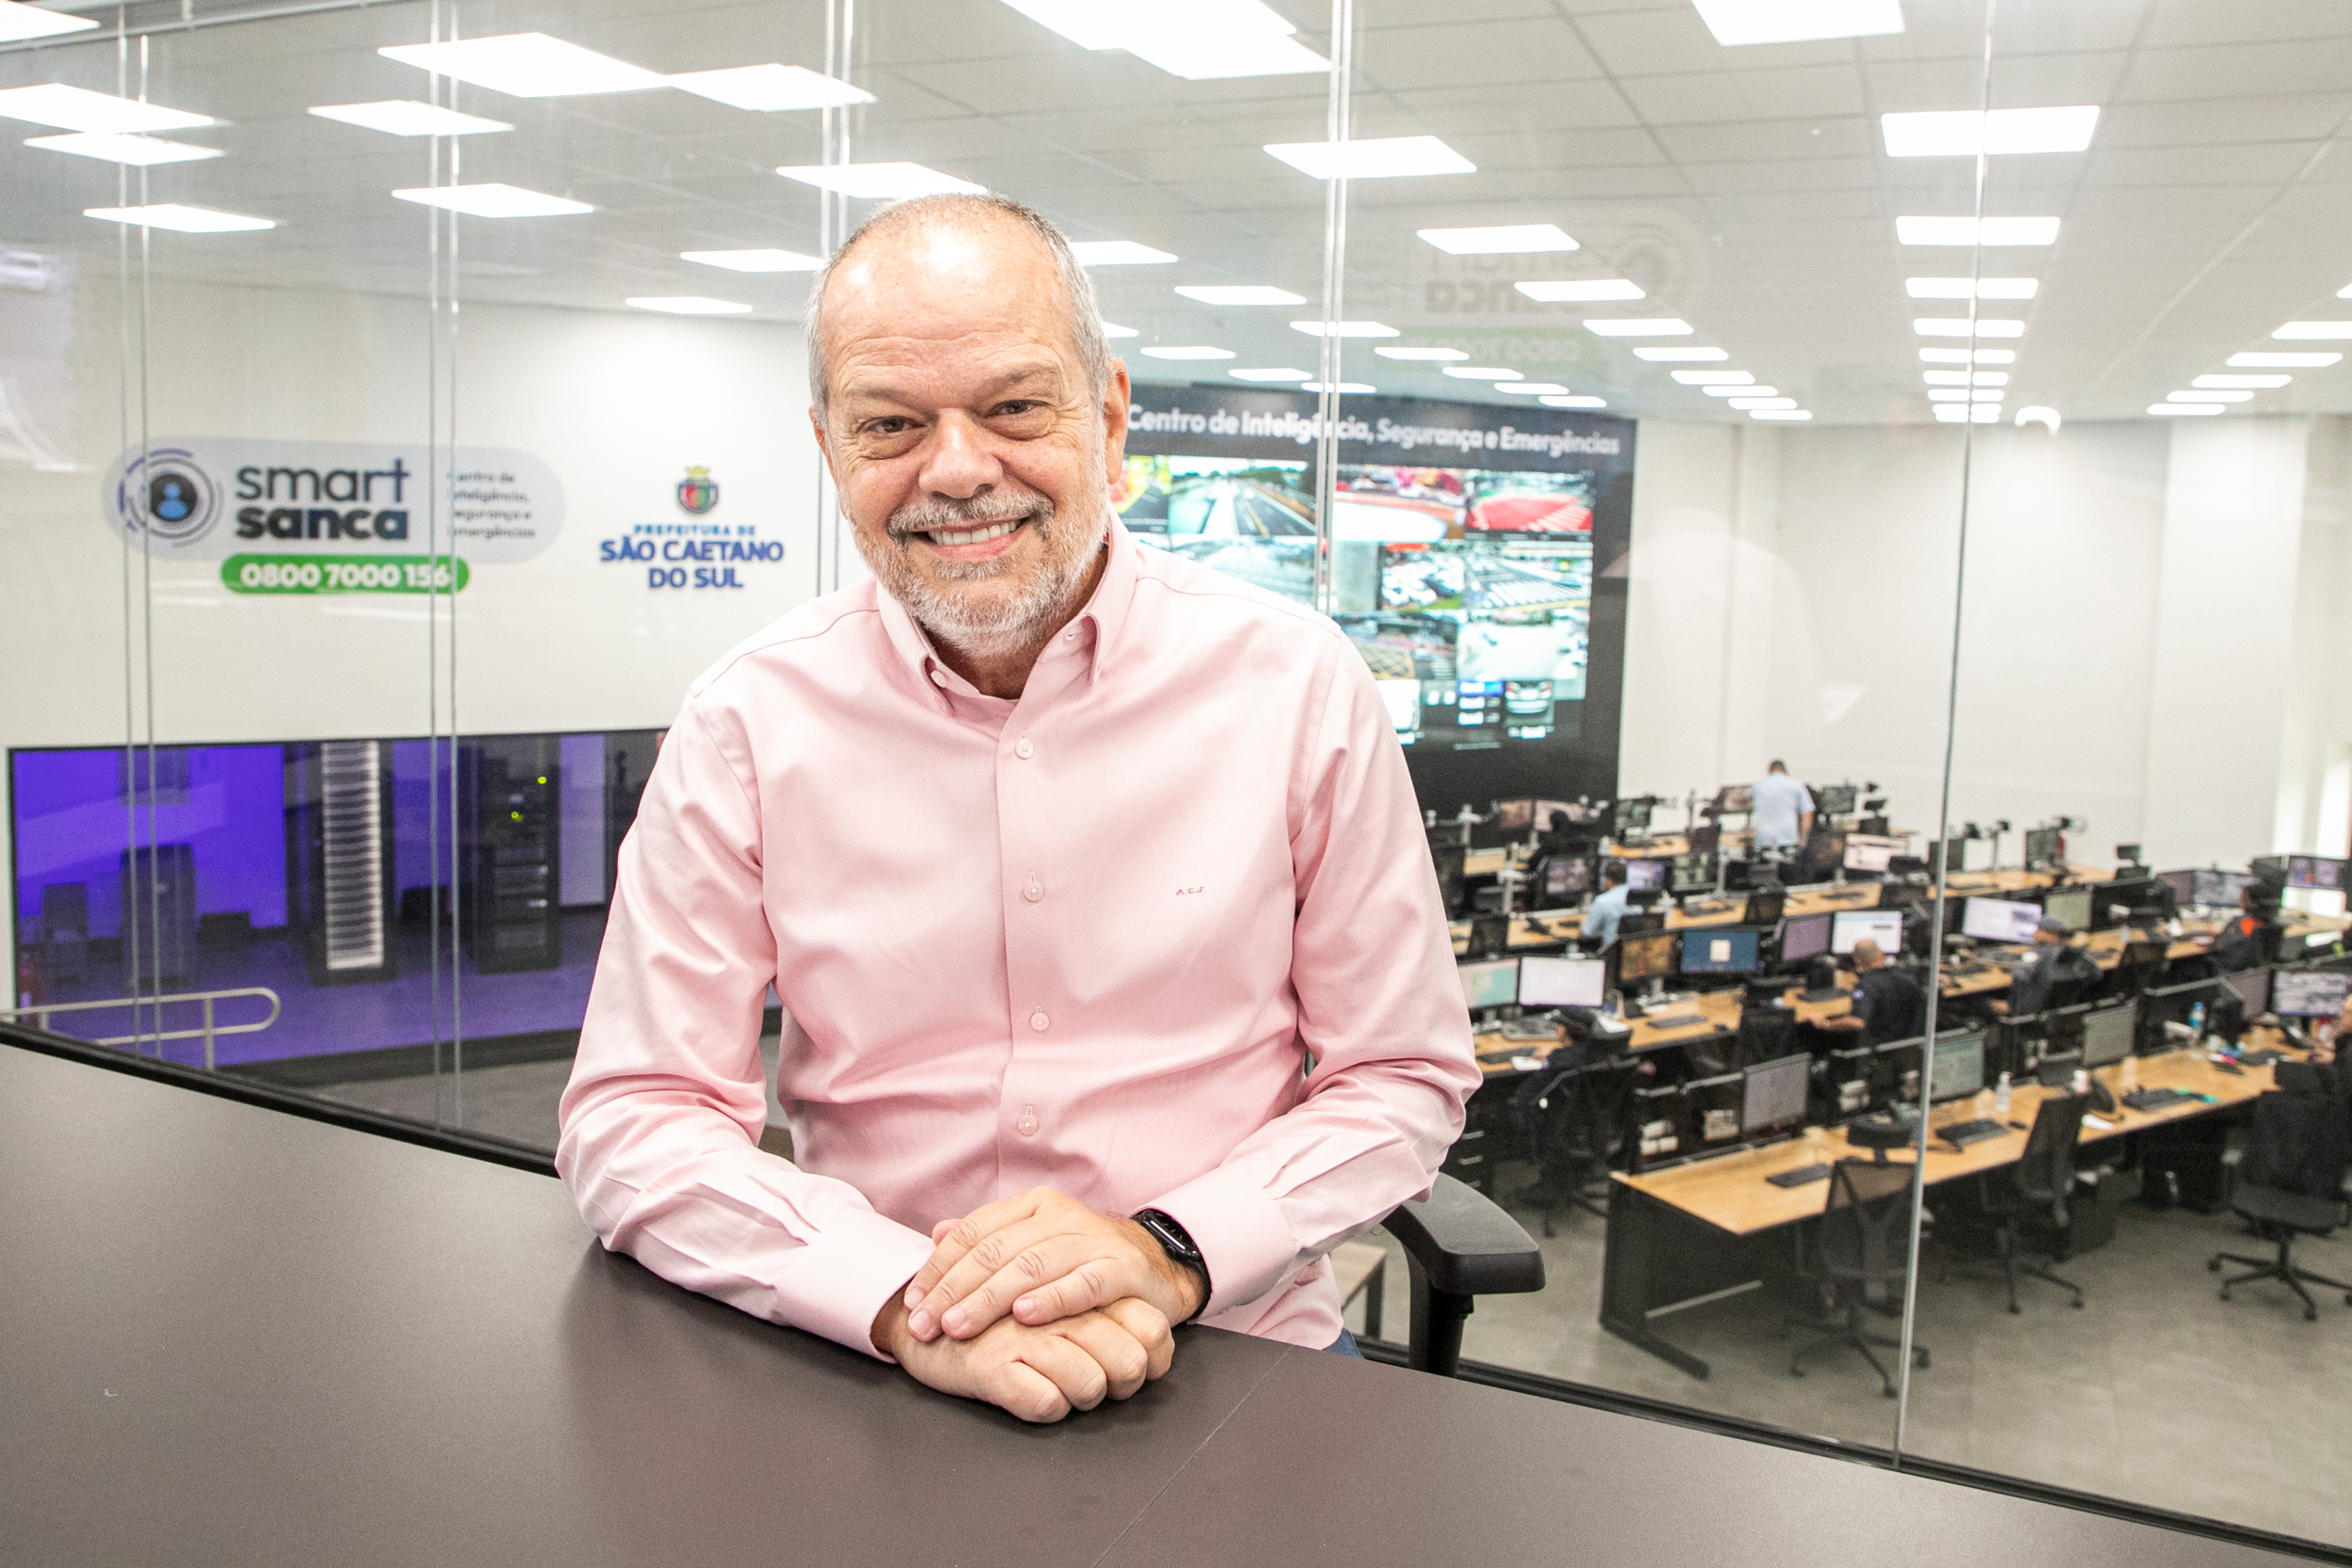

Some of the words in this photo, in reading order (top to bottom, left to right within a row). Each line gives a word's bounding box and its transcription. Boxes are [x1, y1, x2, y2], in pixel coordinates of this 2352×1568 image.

[1127, 404, 1207, 434] Centro
[1208, 407, 1240, 436] de
[1376, 417, 1484, 453] Segurança
[1485, 431, 1498, 450] e
[1499, 426, 1621, 458] Emergências
[236, 457, 411, 502] smart
[236, 507, 408, 540] sanca
[633, 524, 730, 536] PREFEITURA
[737, 525, 755, 536] DE
[599, 535, 656, 562] SÃO
[662, 540, 785, 562] CAETANO
[240, 562, 322, 588] 0800
[323, 563, 401, 588] 7000
[403, 563, 451, 588] 156
[648, 567, 687, 588] DO
[693, 567, 743, 588] SUL
